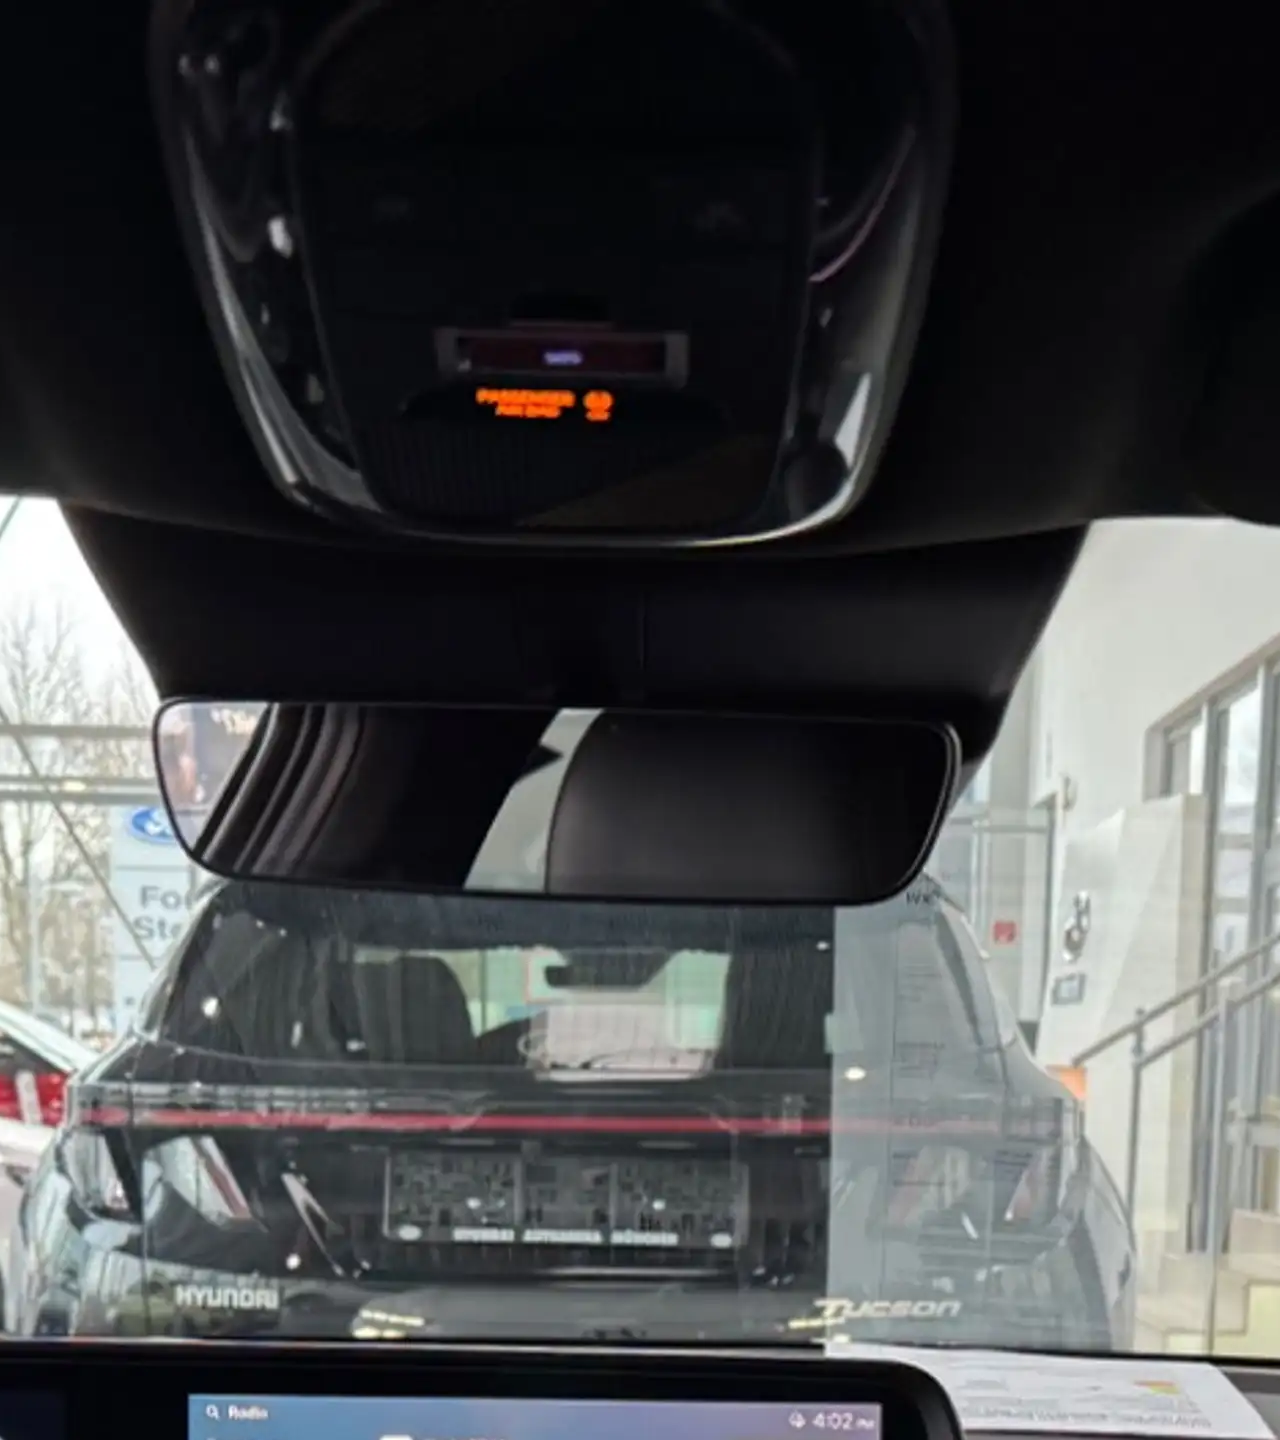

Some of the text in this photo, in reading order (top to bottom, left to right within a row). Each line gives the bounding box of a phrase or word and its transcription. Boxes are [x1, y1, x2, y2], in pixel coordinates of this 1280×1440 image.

[175, 1283, 279, 1310] HYUNDAI
[228, 1404, 269, 1420] Radio
[812, 1411, 854, 1430] 4:02
